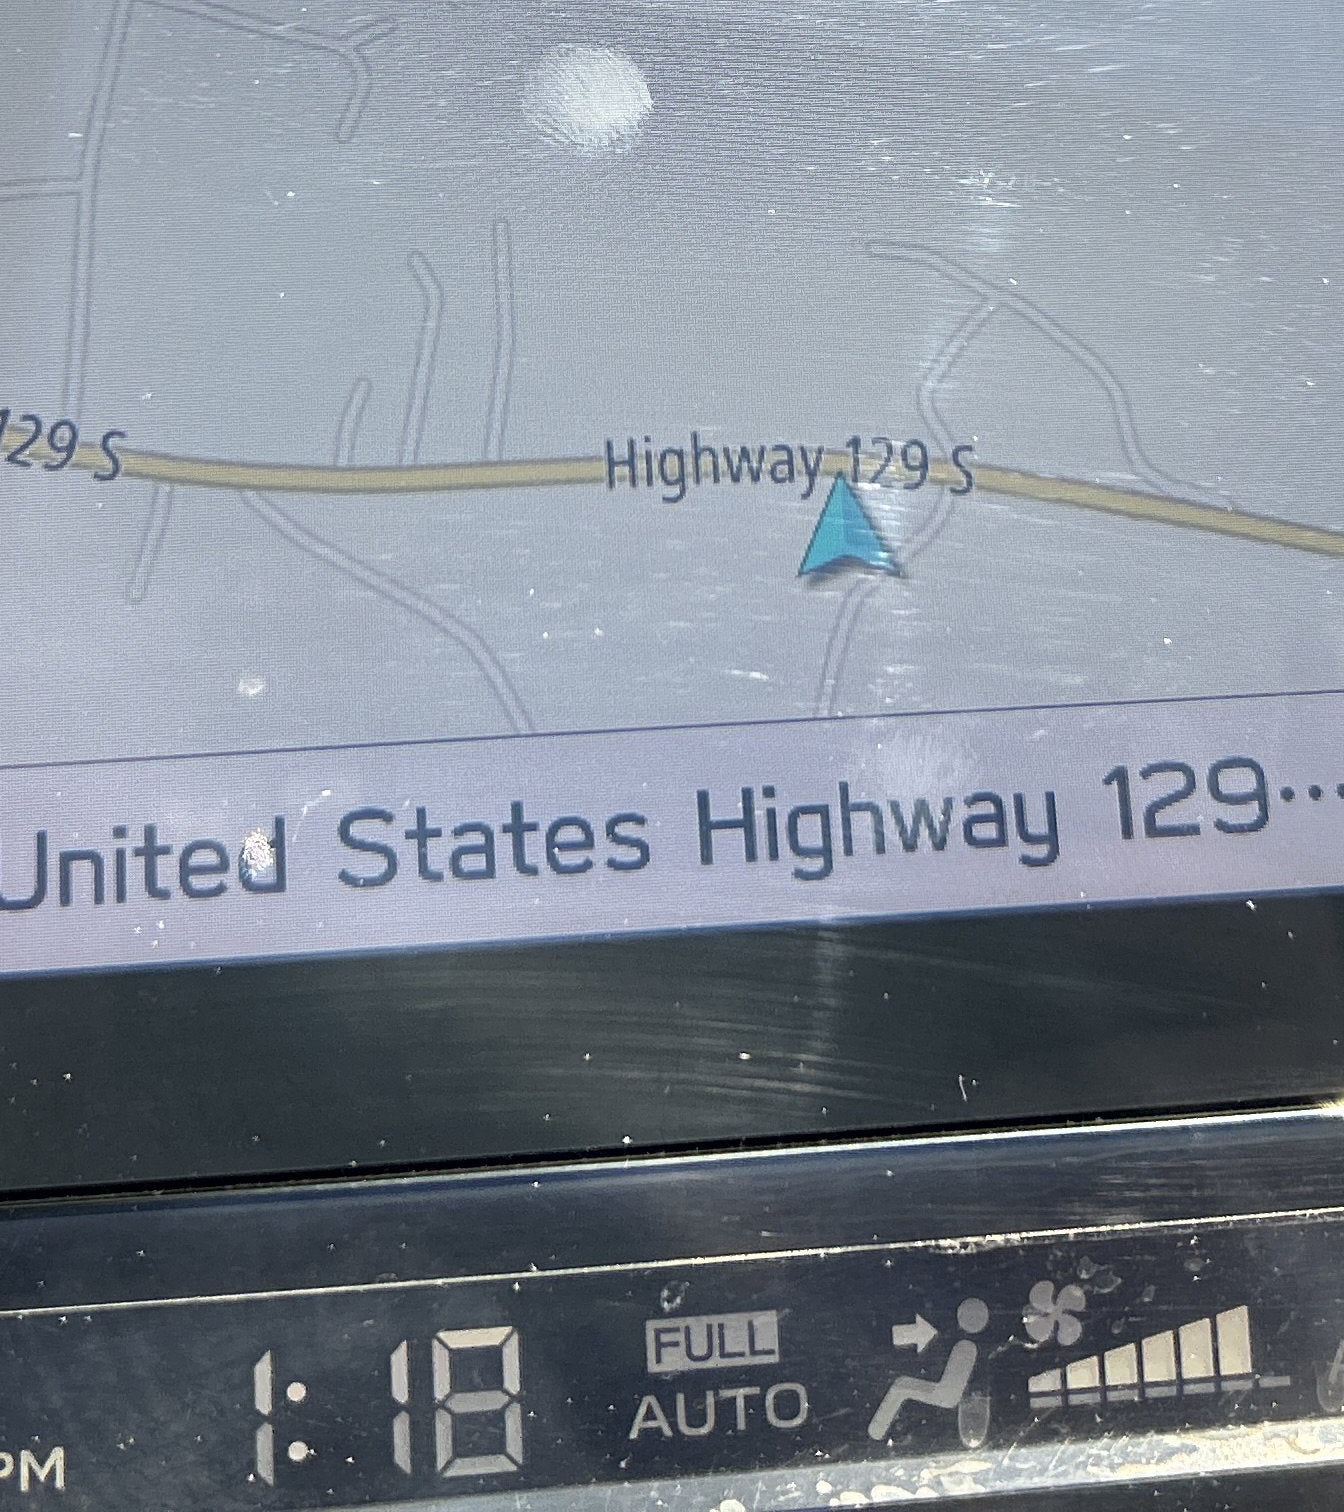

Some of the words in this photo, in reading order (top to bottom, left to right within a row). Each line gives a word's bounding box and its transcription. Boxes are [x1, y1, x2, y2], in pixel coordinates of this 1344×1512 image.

[93, 430, 128, 483] S
[605, 431, 826, 504] Highway
[845, 435, 930, 491] 129
[950, 443, 977, 496] S
[338, 806, 651, 890] States
[695, 780, 1062, 882] Highway
[653, 1318, 777, 1365] FULL
[253, 1324, 526, 1488] 1:18
[627, 1381, 810, 1440] AUTO
